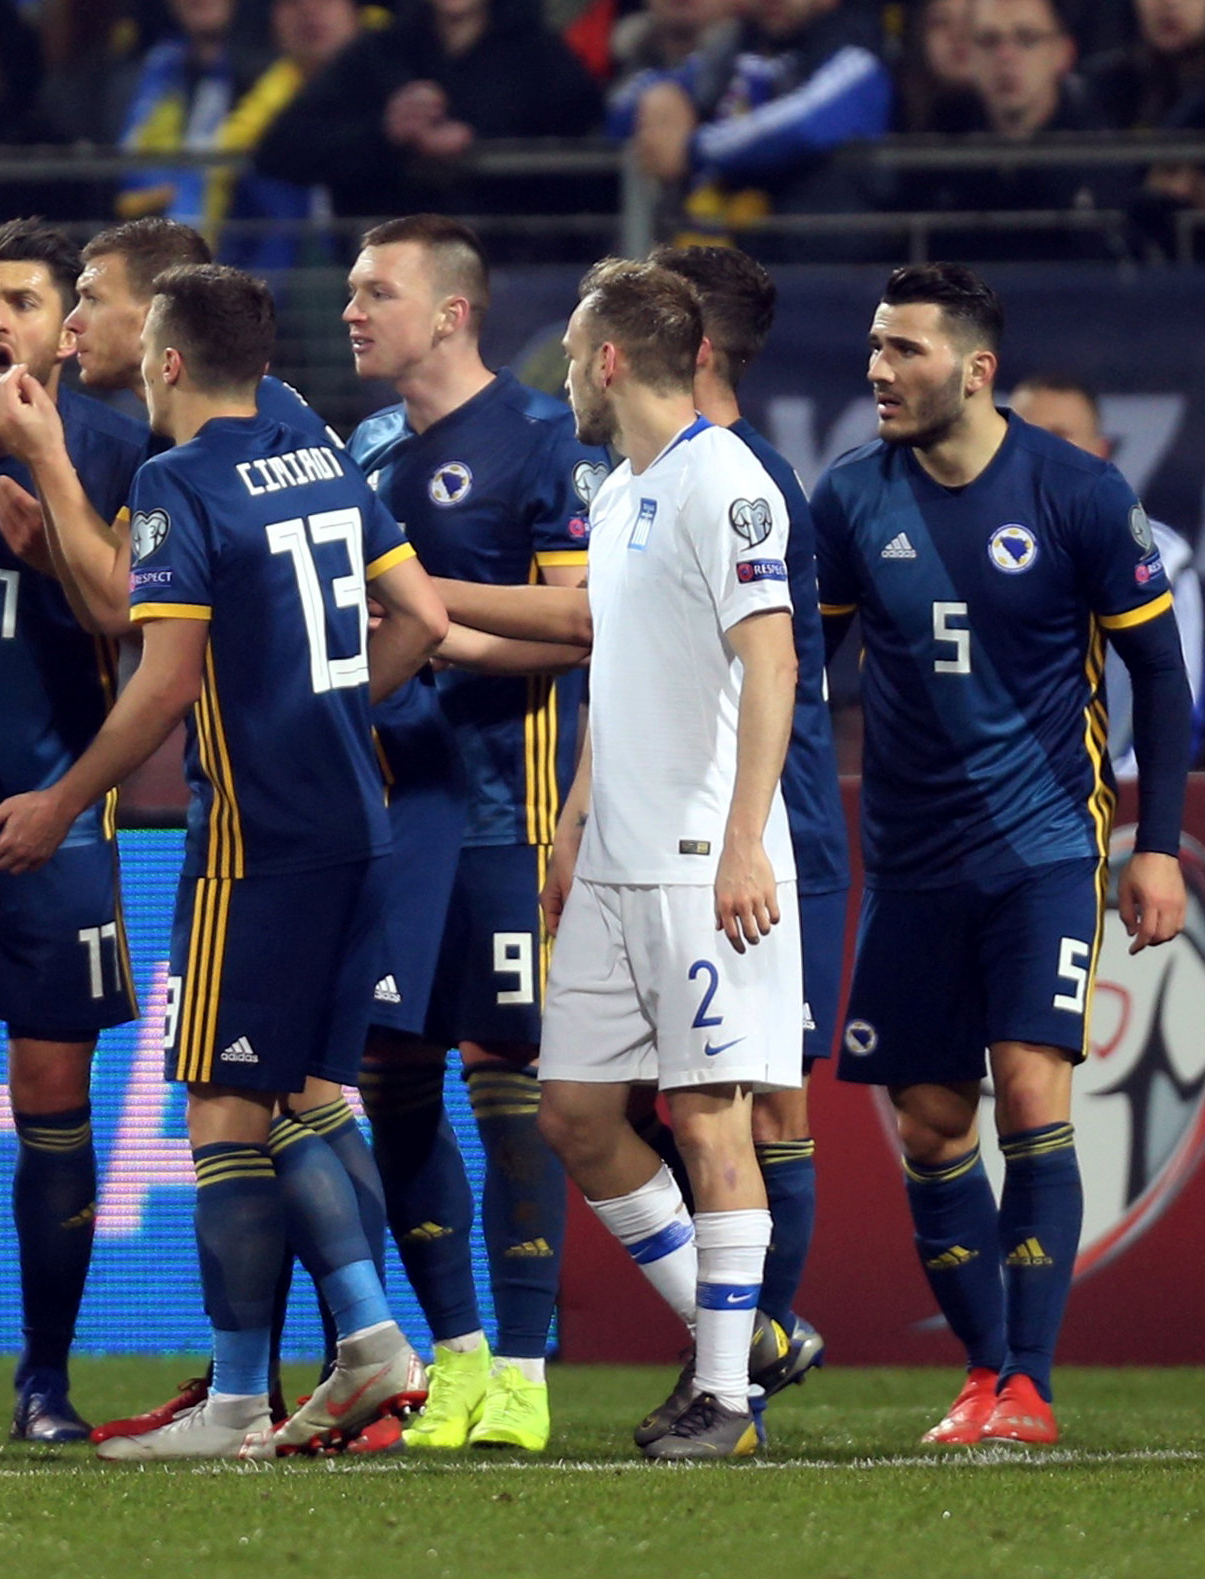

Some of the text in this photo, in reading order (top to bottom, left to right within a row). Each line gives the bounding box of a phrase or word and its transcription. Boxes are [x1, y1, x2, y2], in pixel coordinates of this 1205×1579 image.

[265, 507, 370, 694] 13
[932, 601, 972, 674] 5
[493, 932, 535, 1005] 9
[688, 959, 725, 1029] 2
[1053, 936, 1089, 1014] 5
[220, 1052, 259, 1064] adidas
